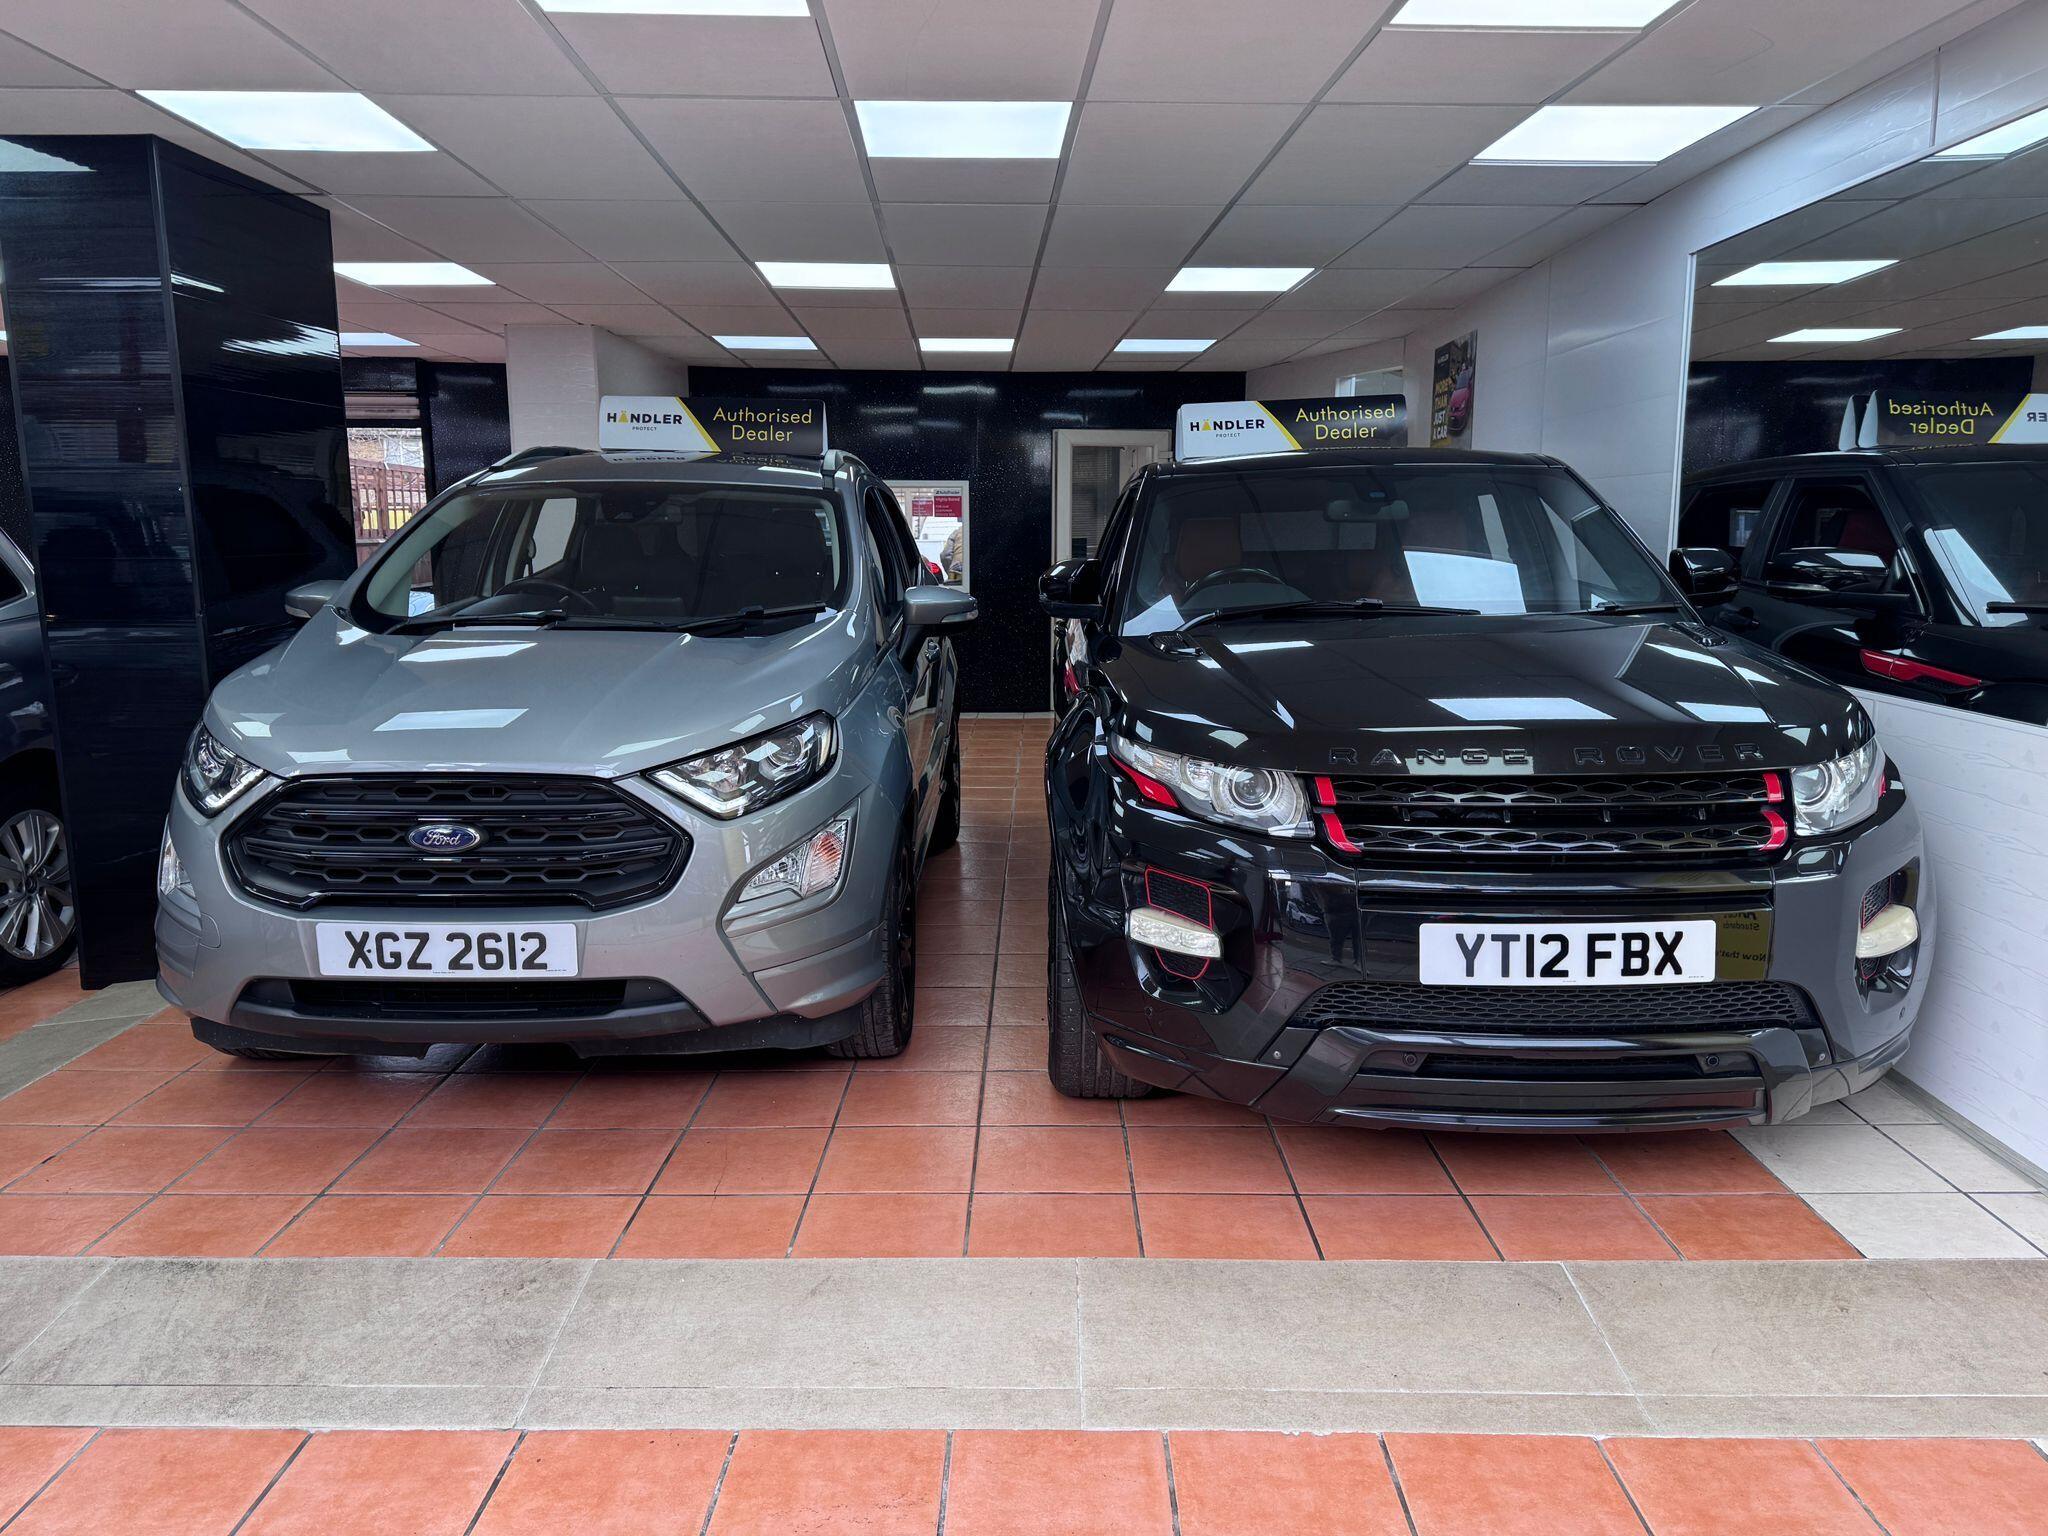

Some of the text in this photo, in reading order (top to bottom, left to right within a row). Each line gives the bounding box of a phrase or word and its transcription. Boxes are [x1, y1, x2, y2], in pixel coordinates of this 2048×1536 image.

[712, 407, 812, 424] Authorised
[1295, 402, 1396, 422] Authorised
[732, 425, 793, 442] Dealer
[1315, 422, 1378, 440] Dealer
[1328, 743, 1766, 766] RANGE ROVER
[423, 829, 461, 845] Ford
[344, 931, 548, 970] XGZ 2612
[1455, 931, 1684, 978] YT12 FBX
